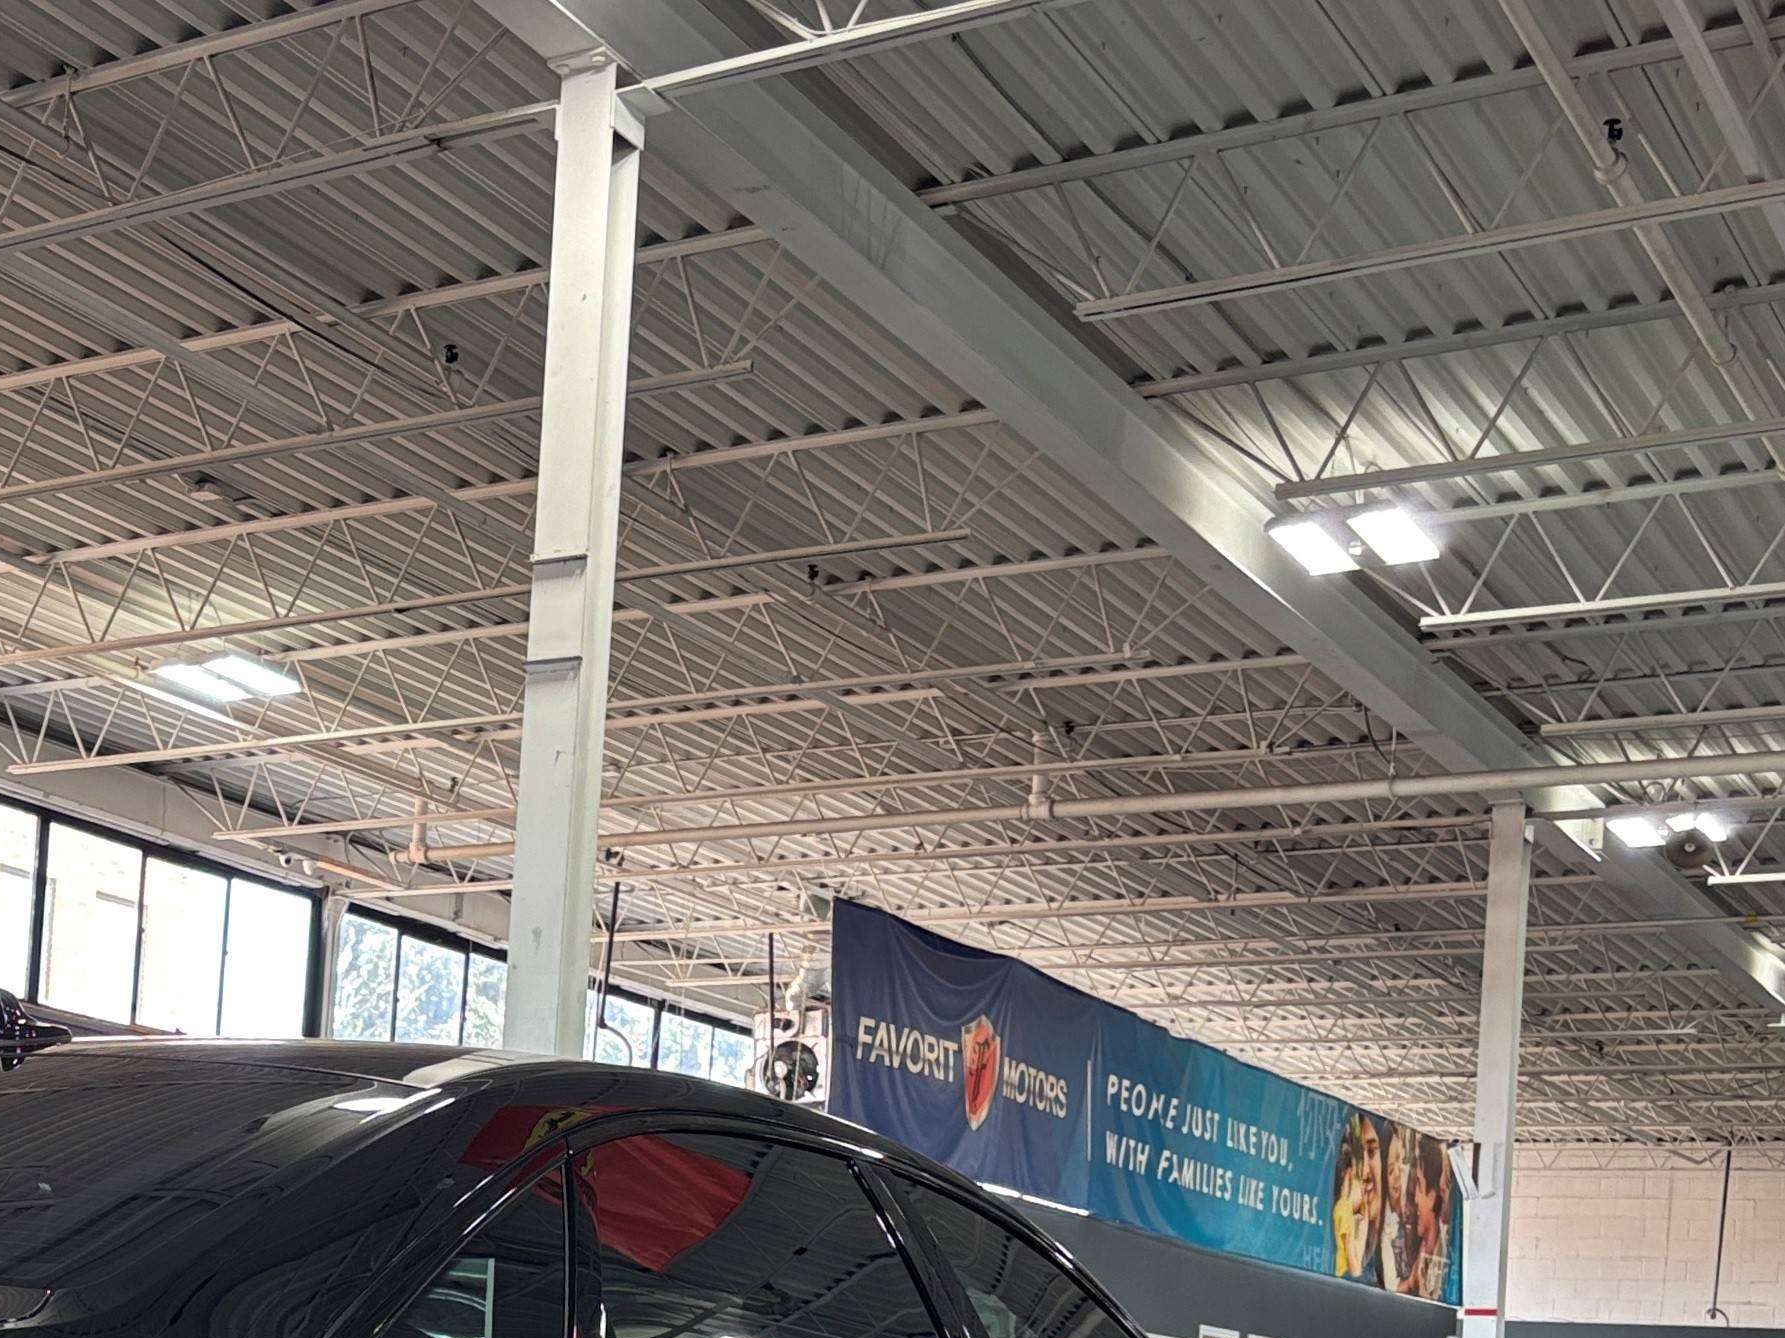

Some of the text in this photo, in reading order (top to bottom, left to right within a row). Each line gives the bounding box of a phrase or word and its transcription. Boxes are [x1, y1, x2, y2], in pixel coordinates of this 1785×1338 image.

[856, 1016, 959, 1083] FAVORIT
[1002, 1056, 1068, 1119] MOTORS
[1181, 1103, 1220, 1143] JUST
[1226, 1117, 1258, 1156] LIKE
[1105, 1130, 1150, 1176] WITH
[1156, 1149, 1233, 1201] FAMILIES
[1238, 1174, 1265, 1211] LIKE
